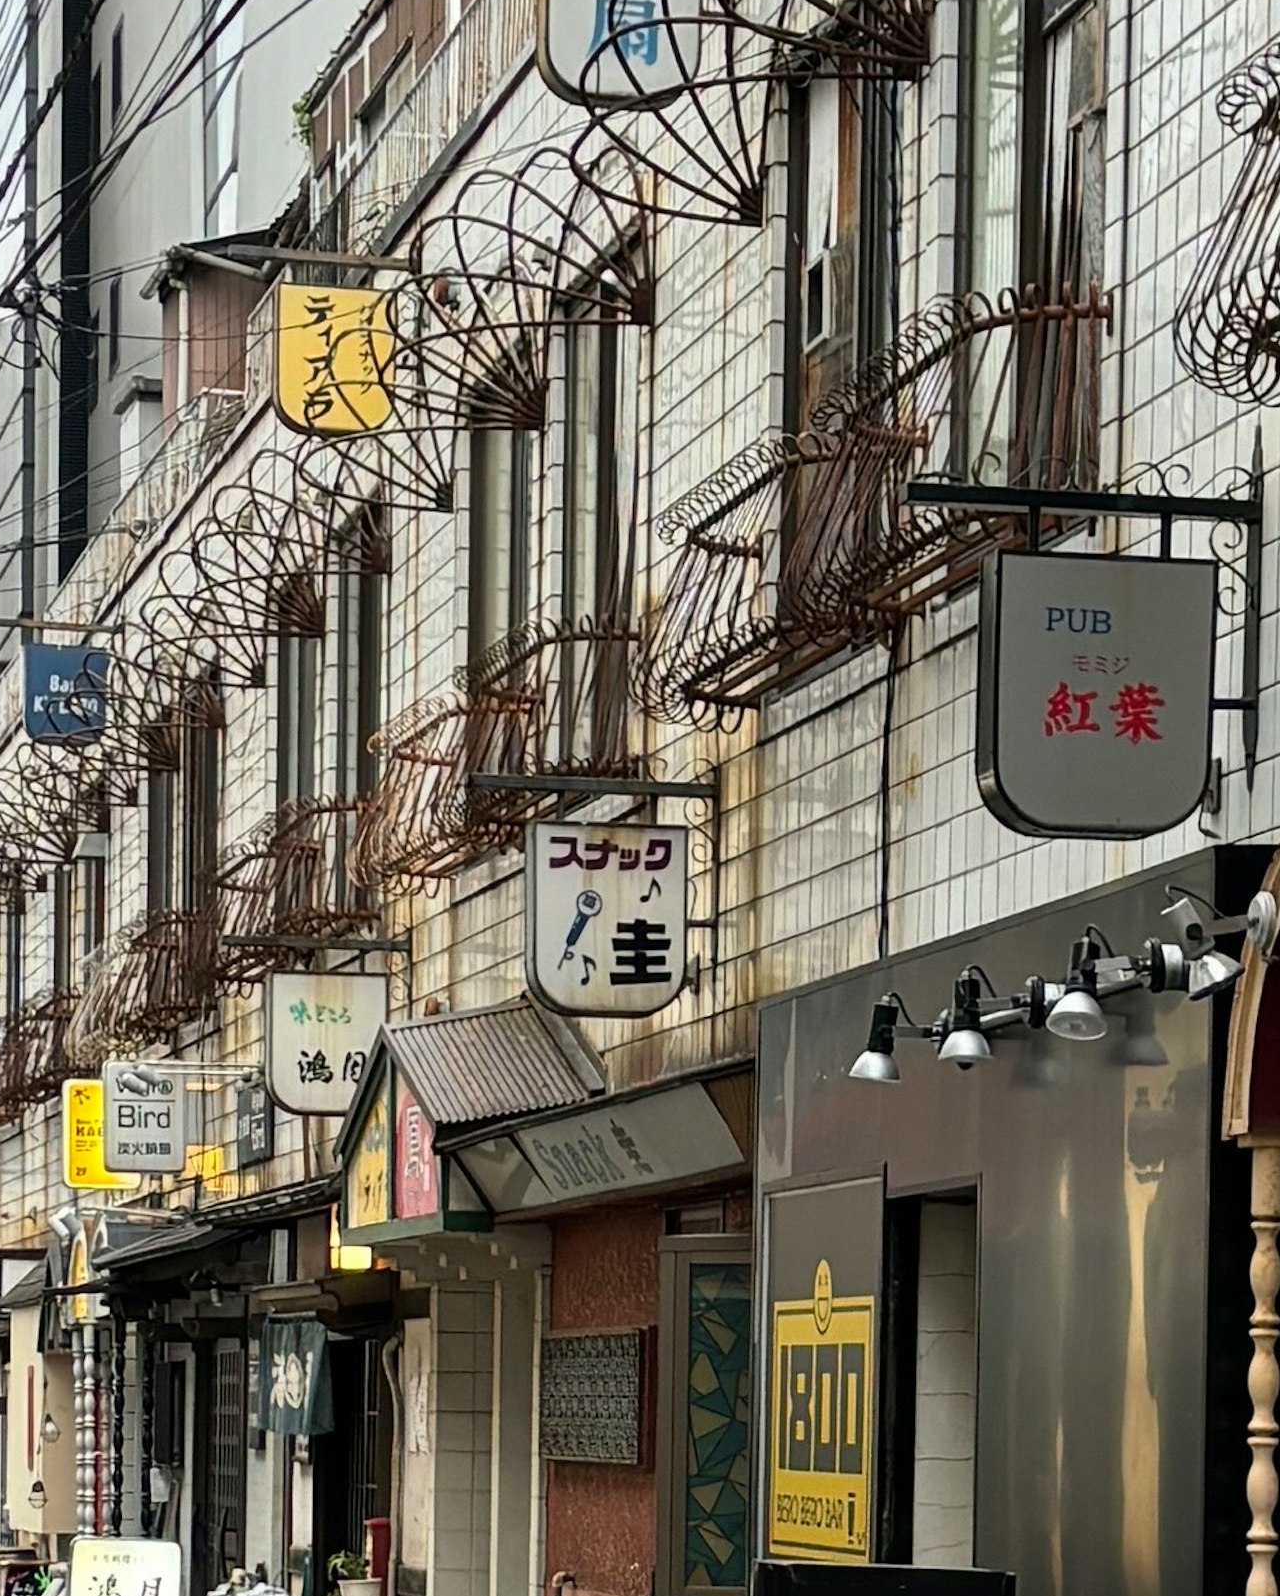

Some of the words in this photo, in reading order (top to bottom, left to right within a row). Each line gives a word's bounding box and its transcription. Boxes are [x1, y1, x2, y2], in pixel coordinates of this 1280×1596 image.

[1046, 607, 1112, 634] PUB
[1073, 655, 1130, 675] モミジ
[1043, 681, 1166, 745] 紅葉
[549, 837, 672, 871] スナック
[609, 918, 672, 986] 圭
[117, 1104, 171, 1130] Bird
[531, 1124, 626, 1191] Snack
[779, 1343, 866, 1474] 1800
